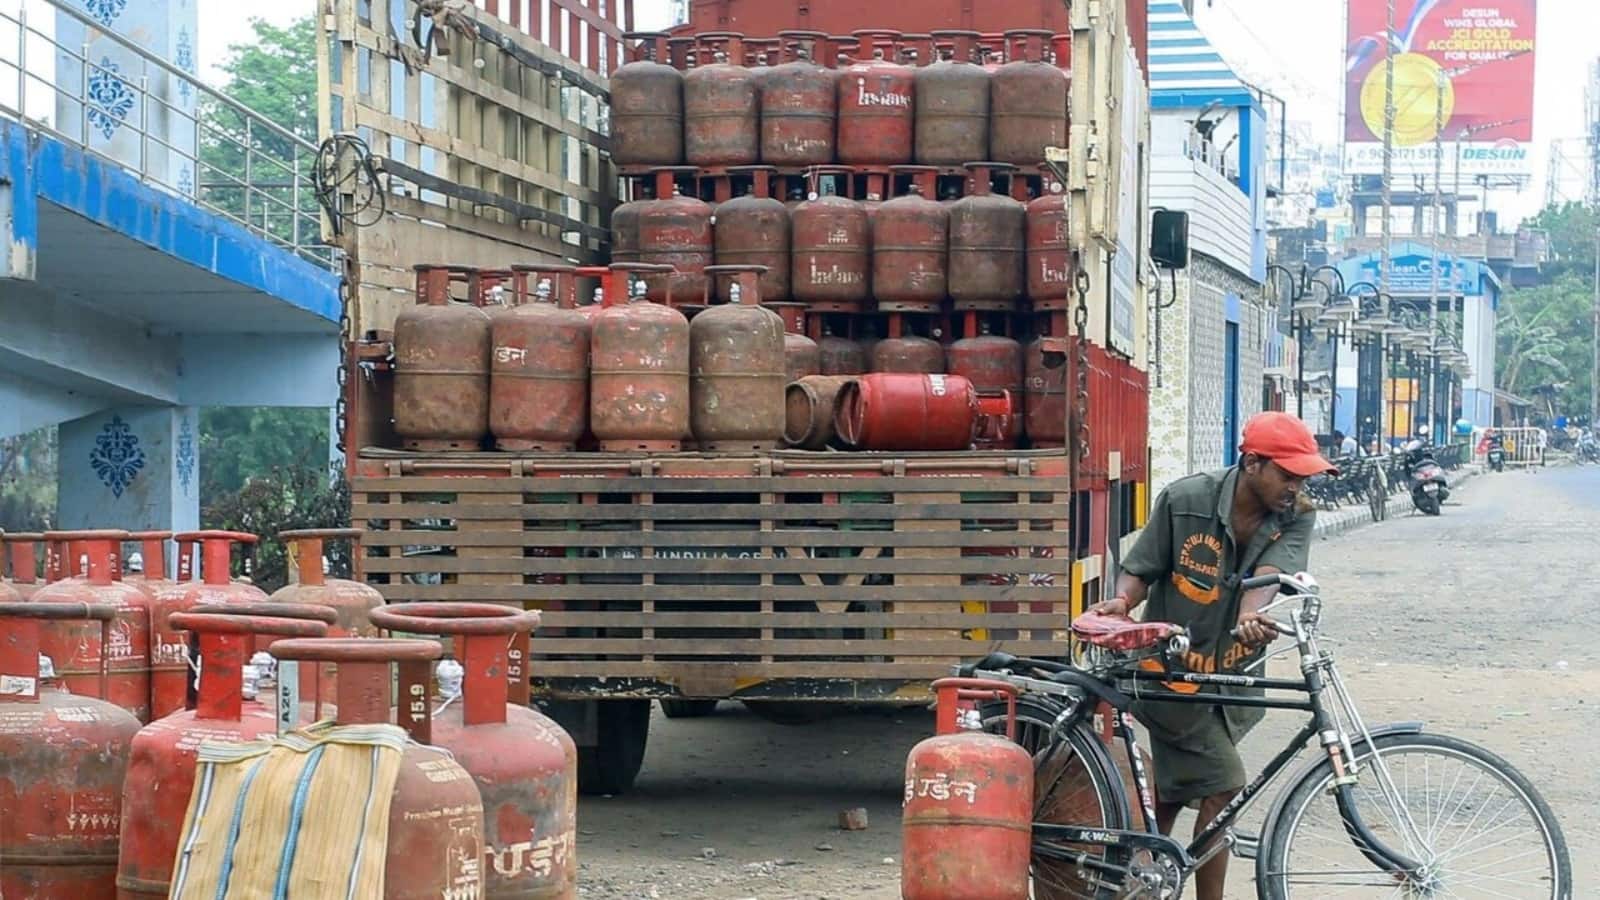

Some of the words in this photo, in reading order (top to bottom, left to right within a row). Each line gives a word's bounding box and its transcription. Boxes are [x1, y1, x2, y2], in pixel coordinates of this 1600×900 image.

[1462, 8, 1499, 18] DESUN
[1444, 18, 1472, 28] WINS
[1475, 18, 1518, 28] GLOBAL
[1451, 29, 1470, 39] JCI
[1472, 28, 1511, 39] GOLD
[1427, 39, 1534, 50] ACCREDITATION
[1444, 52, 1467, 60] FOR
[1463, 148, 1527, 160] DESUN
[508, 649, 522, 685] 15.6
[410, 684, 426, 723] 15.9
